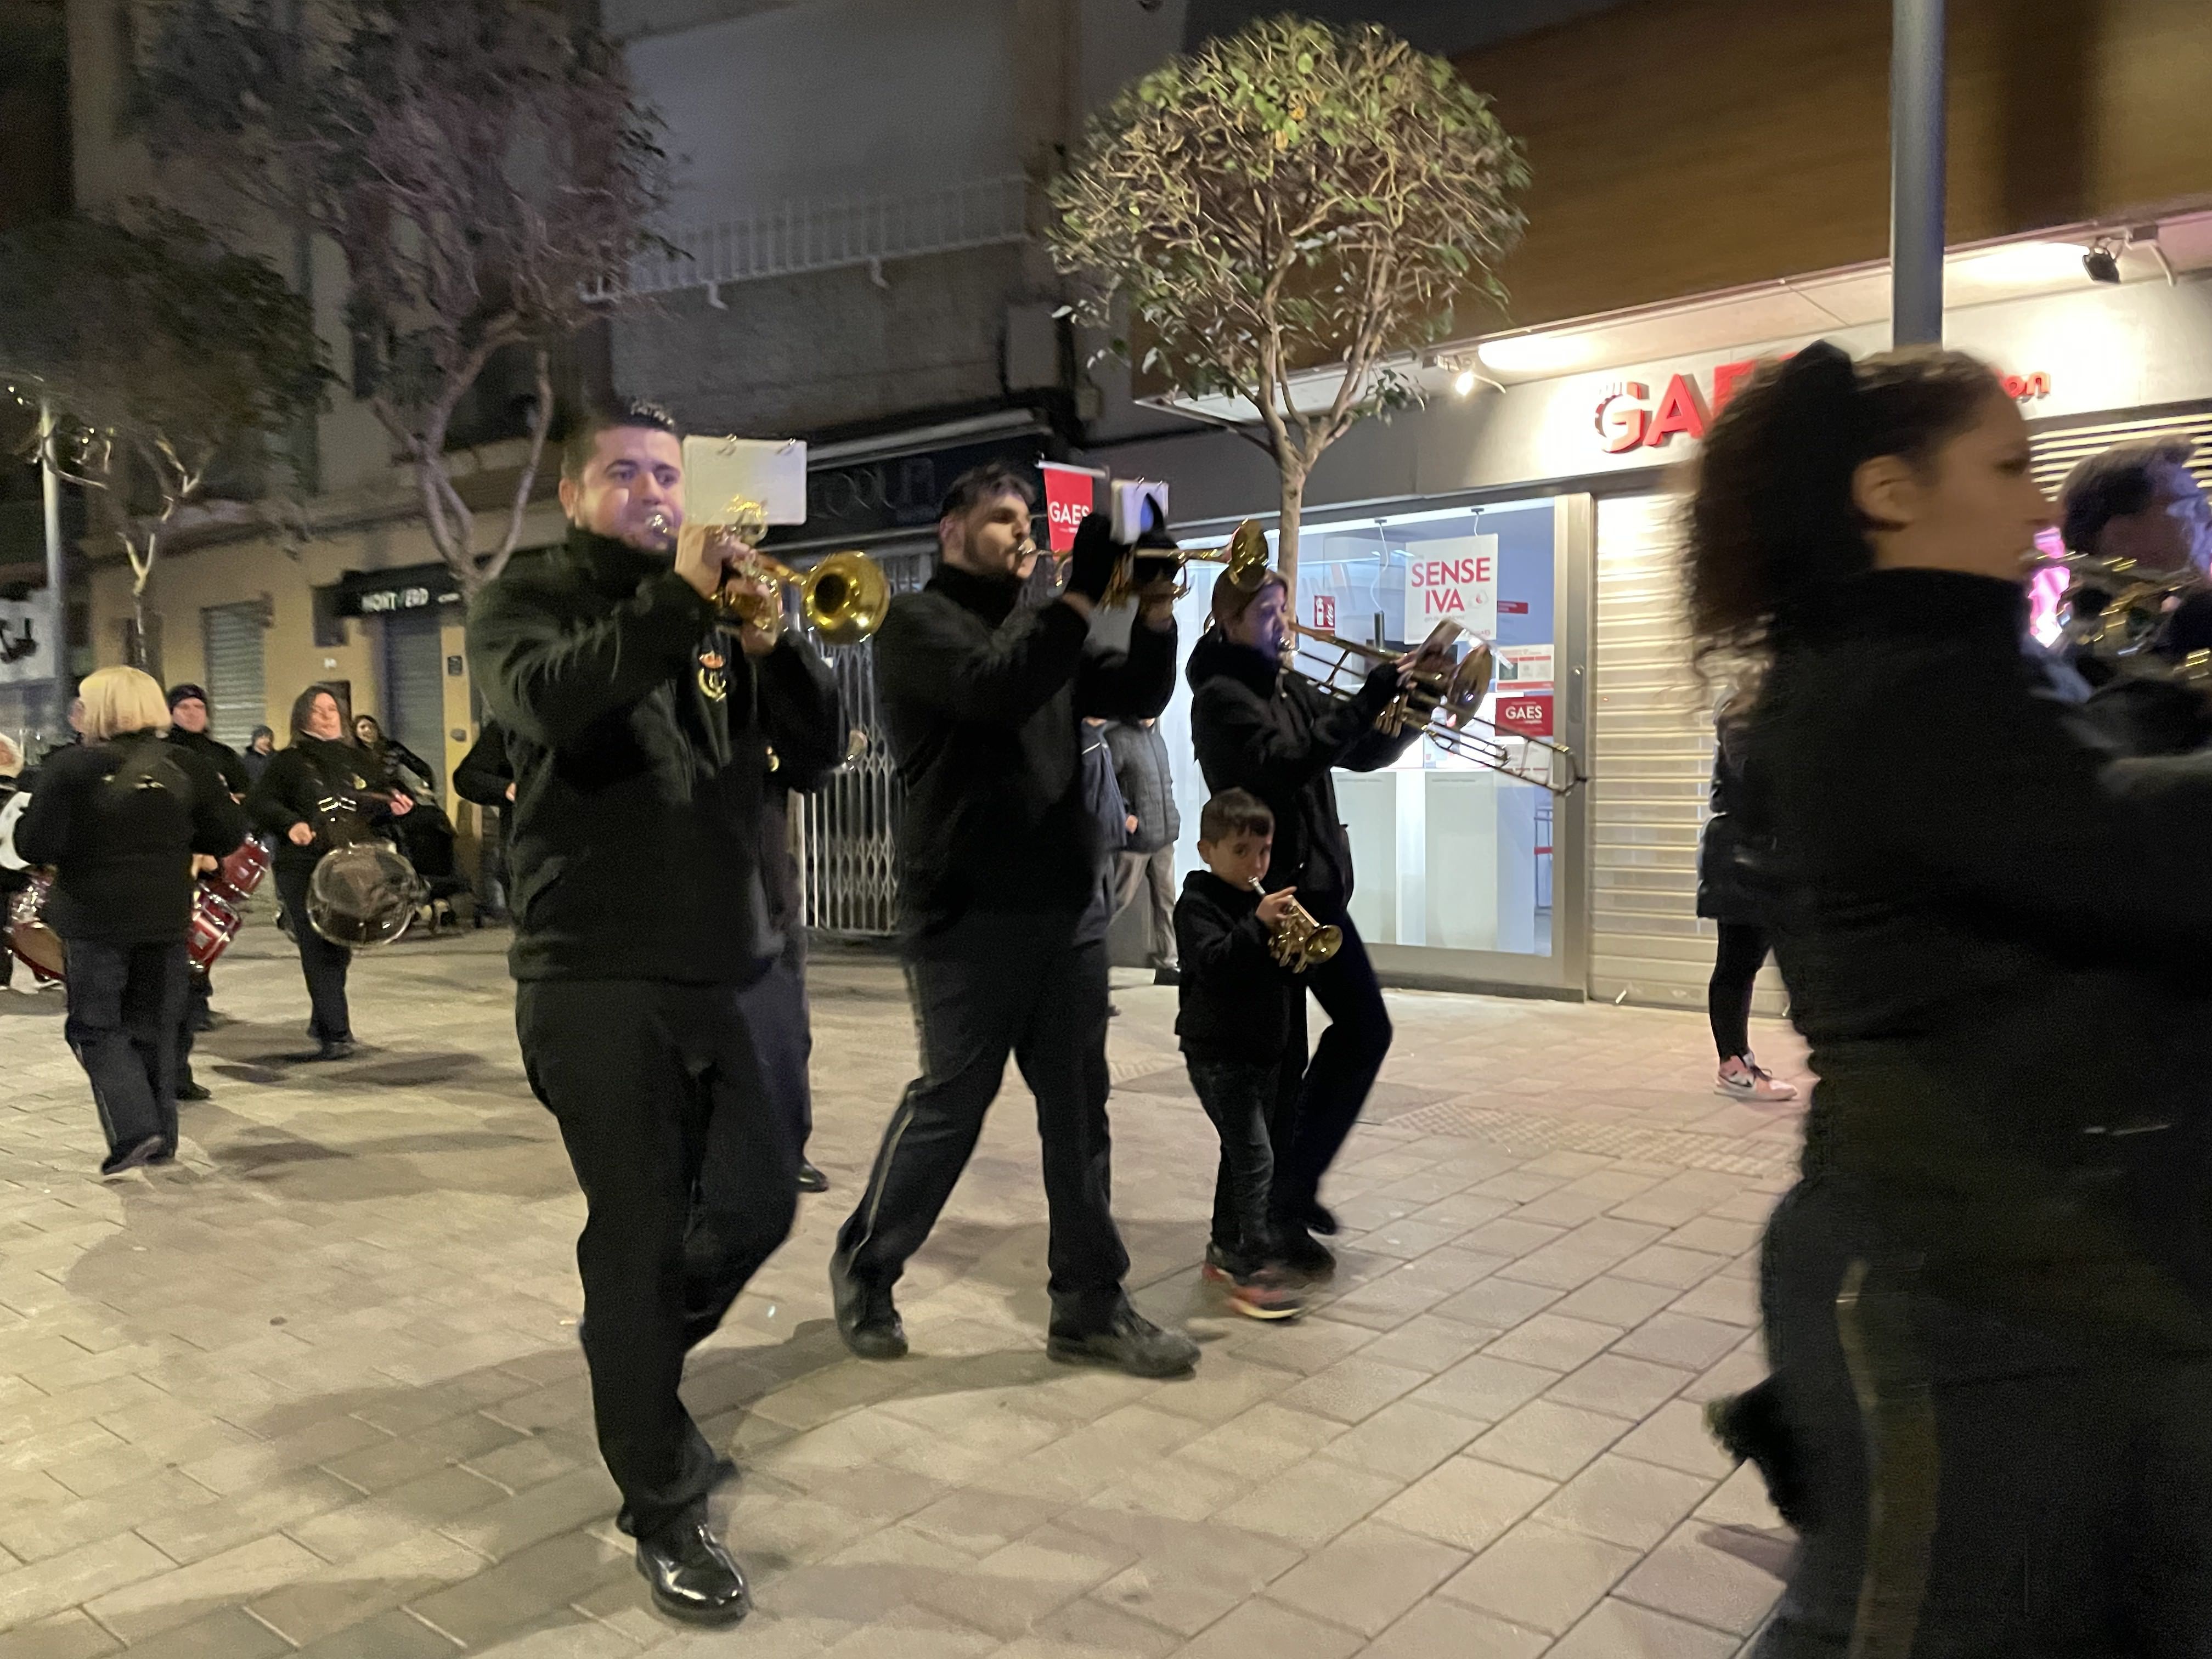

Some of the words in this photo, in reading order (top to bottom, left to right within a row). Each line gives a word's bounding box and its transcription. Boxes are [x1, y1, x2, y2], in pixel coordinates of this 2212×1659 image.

[1594, 356, 1783, 454] GA
[1049, 501, 1090, 525] GAES
[1411, 557, 1491, 588] SENSE
[1425, 588, 1465, 614] IVA
[1505, 705, 1543, 720] GAES
